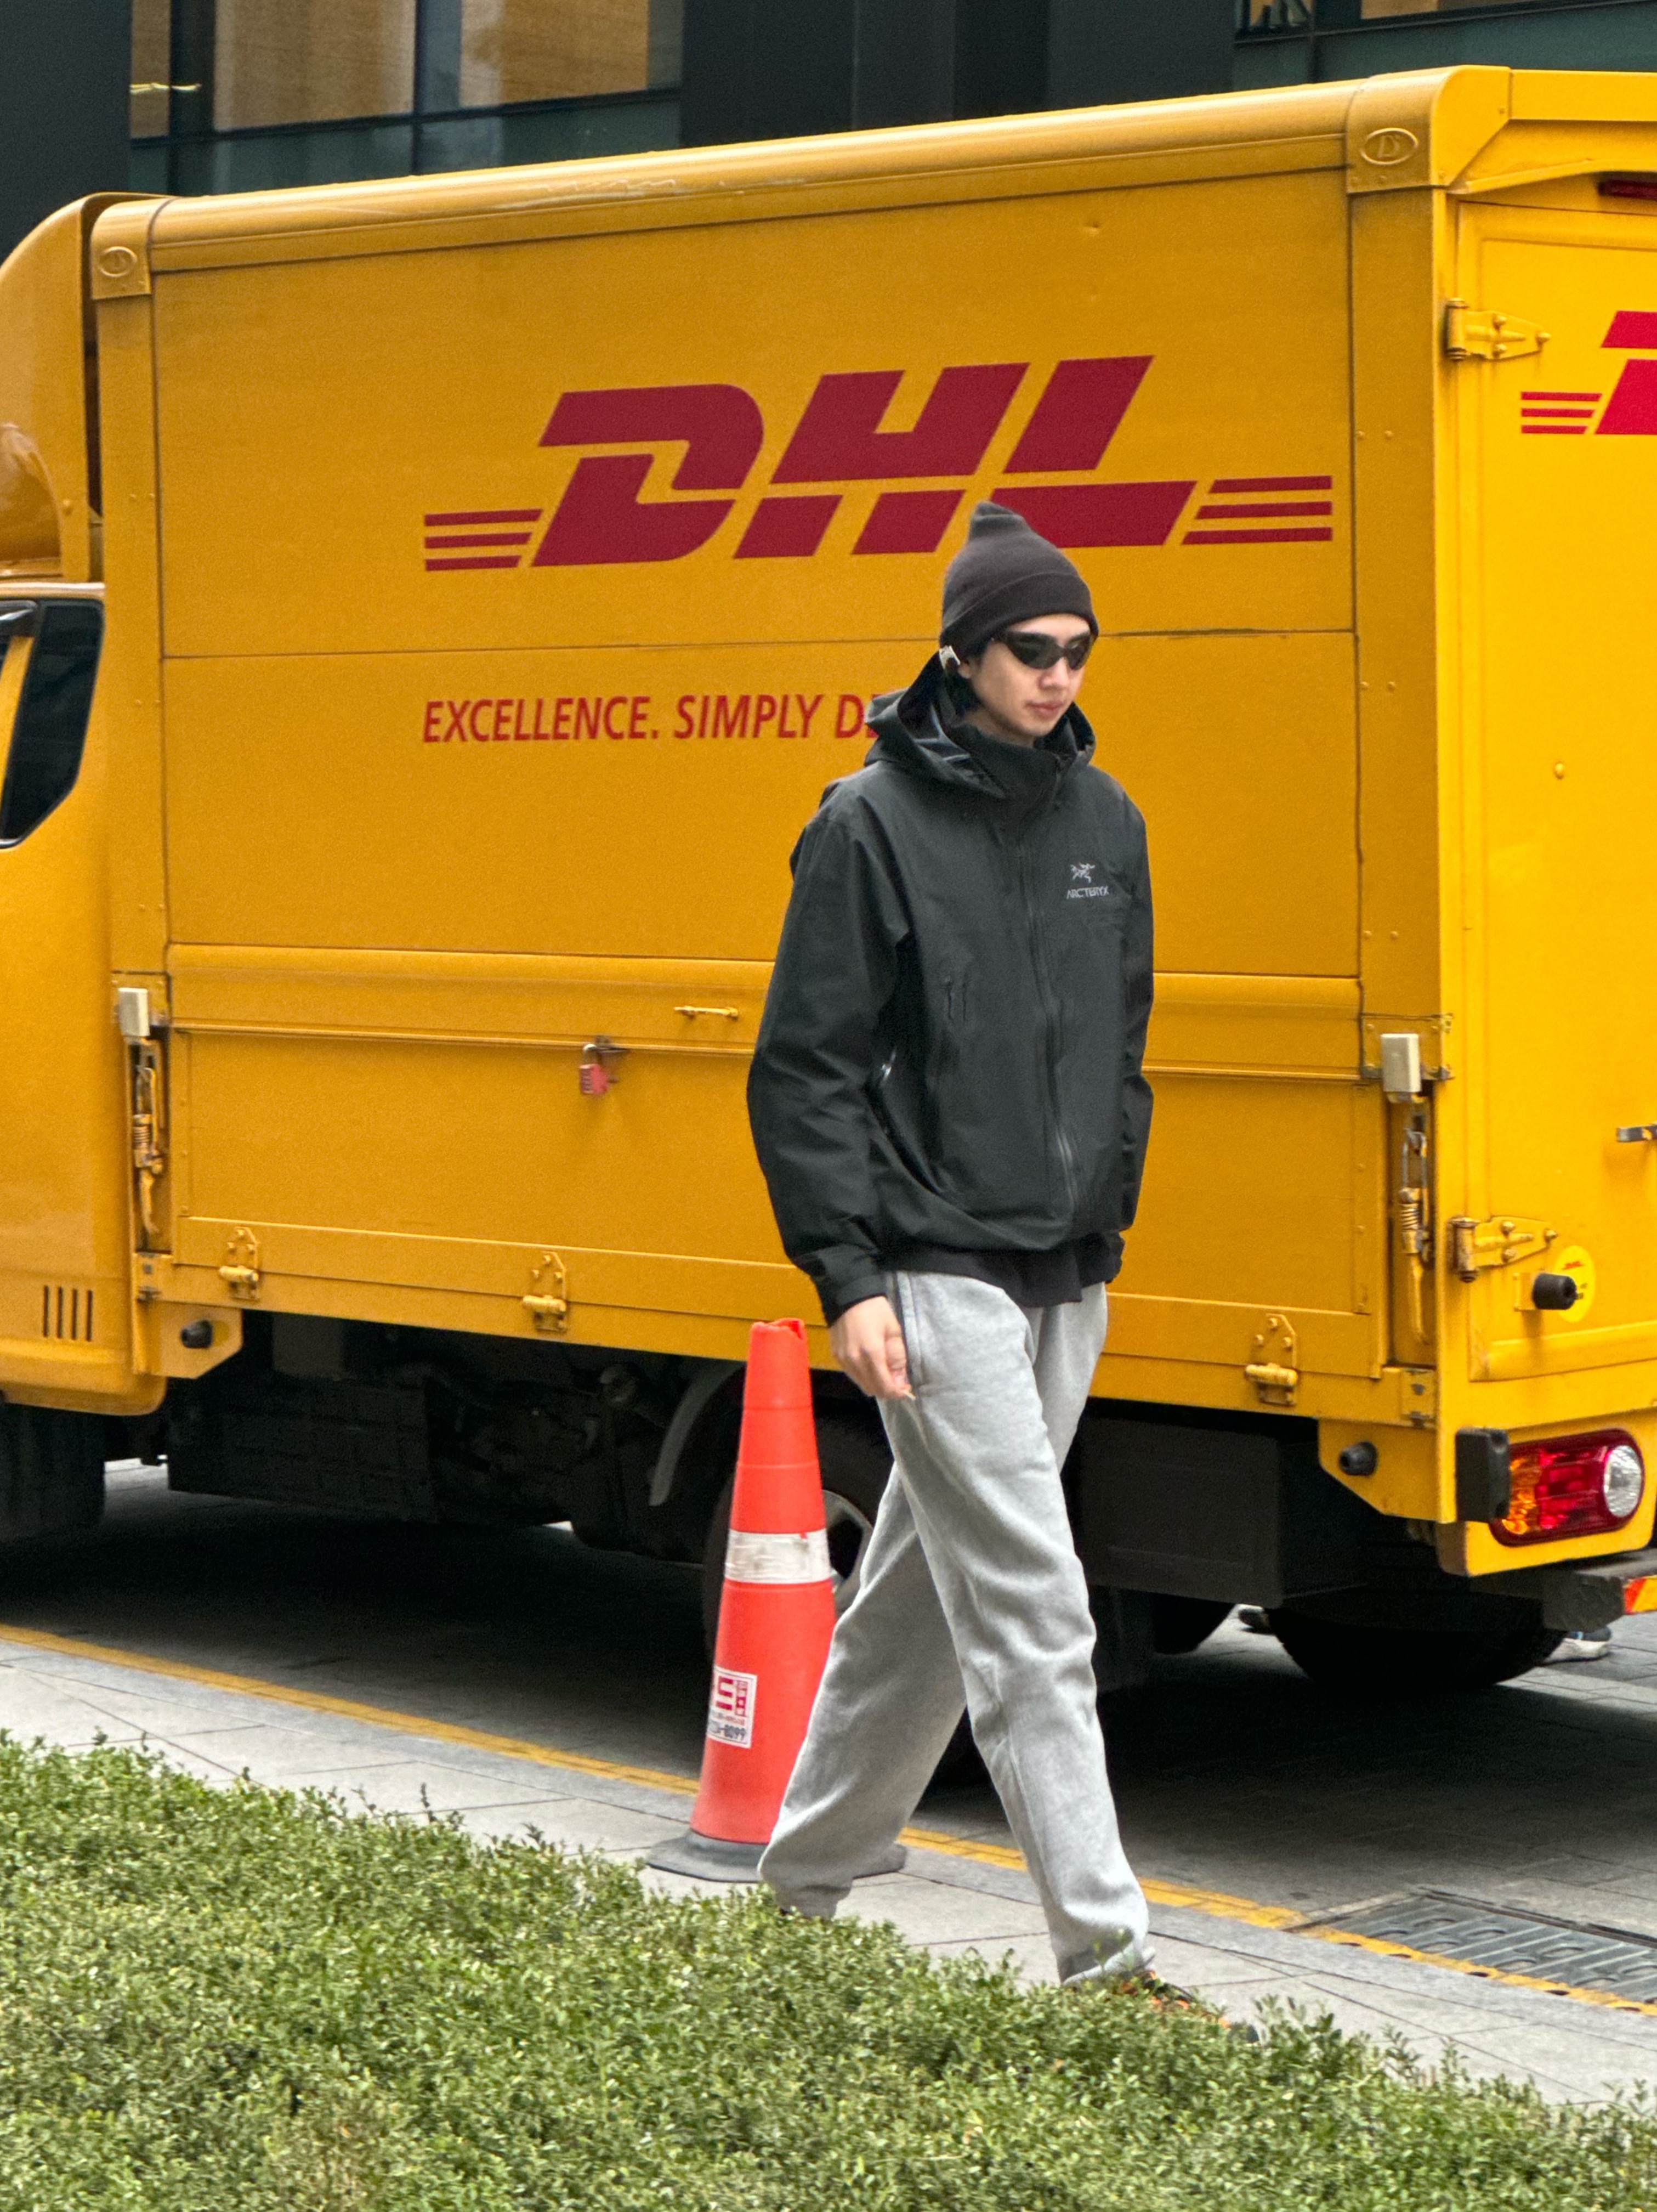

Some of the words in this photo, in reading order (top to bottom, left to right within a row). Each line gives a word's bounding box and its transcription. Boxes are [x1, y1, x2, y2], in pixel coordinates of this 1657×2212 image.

[529, 355, 1196, 567] DHL
[423, 695, 659, 743] EXCELLENCE.
[674, 693, 824, 739] SIMPLY
